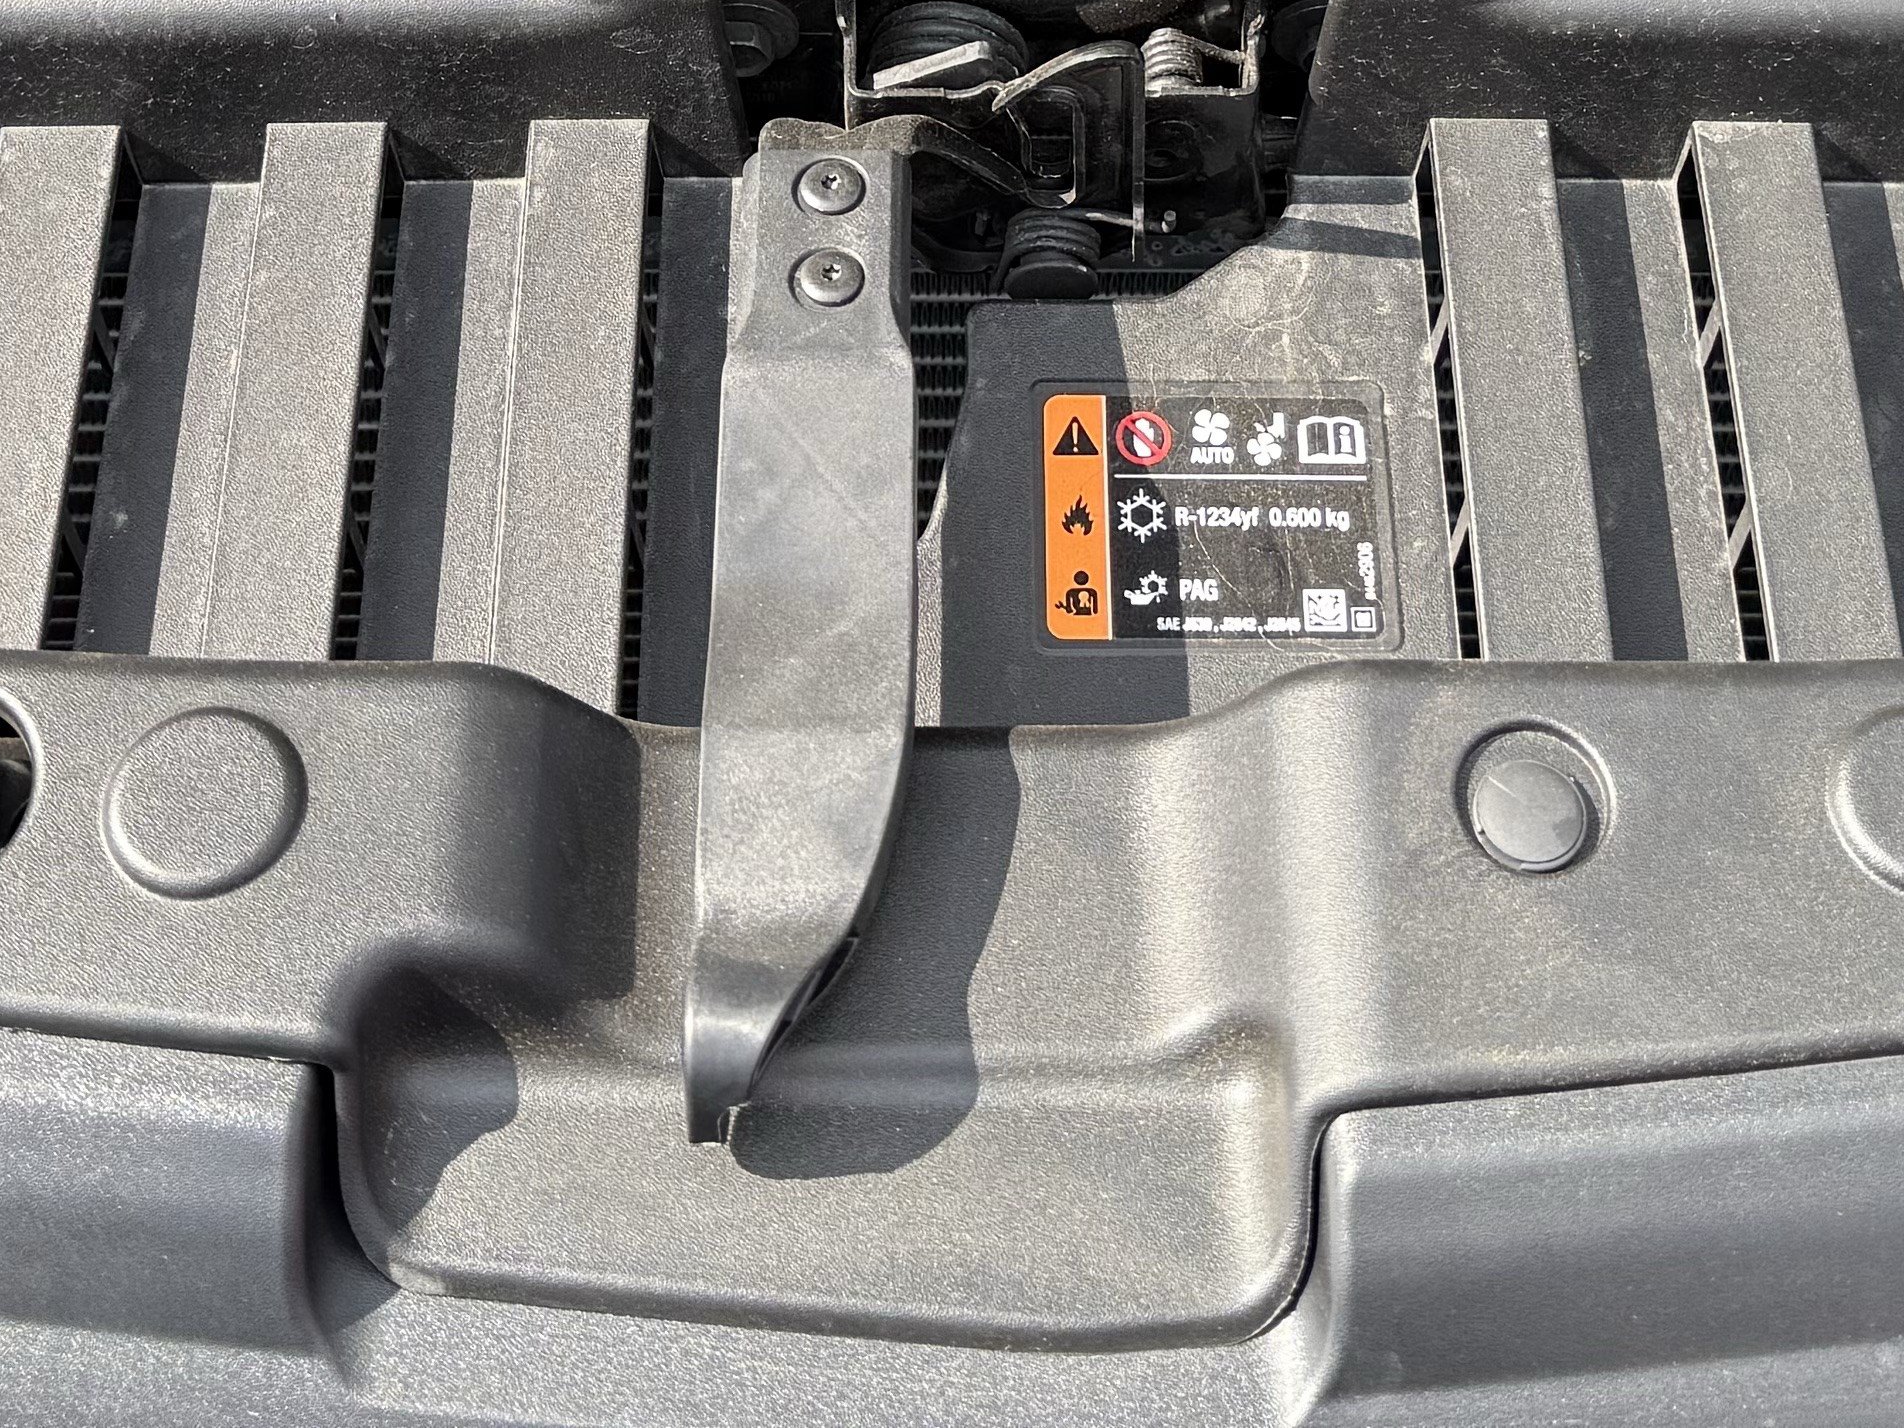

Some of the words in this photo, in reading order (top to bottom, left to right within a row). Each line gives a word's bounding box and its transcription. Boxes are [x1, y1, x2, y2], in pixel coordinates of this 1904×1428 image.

[1190, 446, 1235, 464] AUTO
[1174, 506, 1260, 531] R-1234yf
[1268, 506, 1322, 528] 0.600
[1325, 506, 1350, 532] kg
[1179, 579, 1219, 602] PAG
[1156, 616, 1182, 632] SAE
